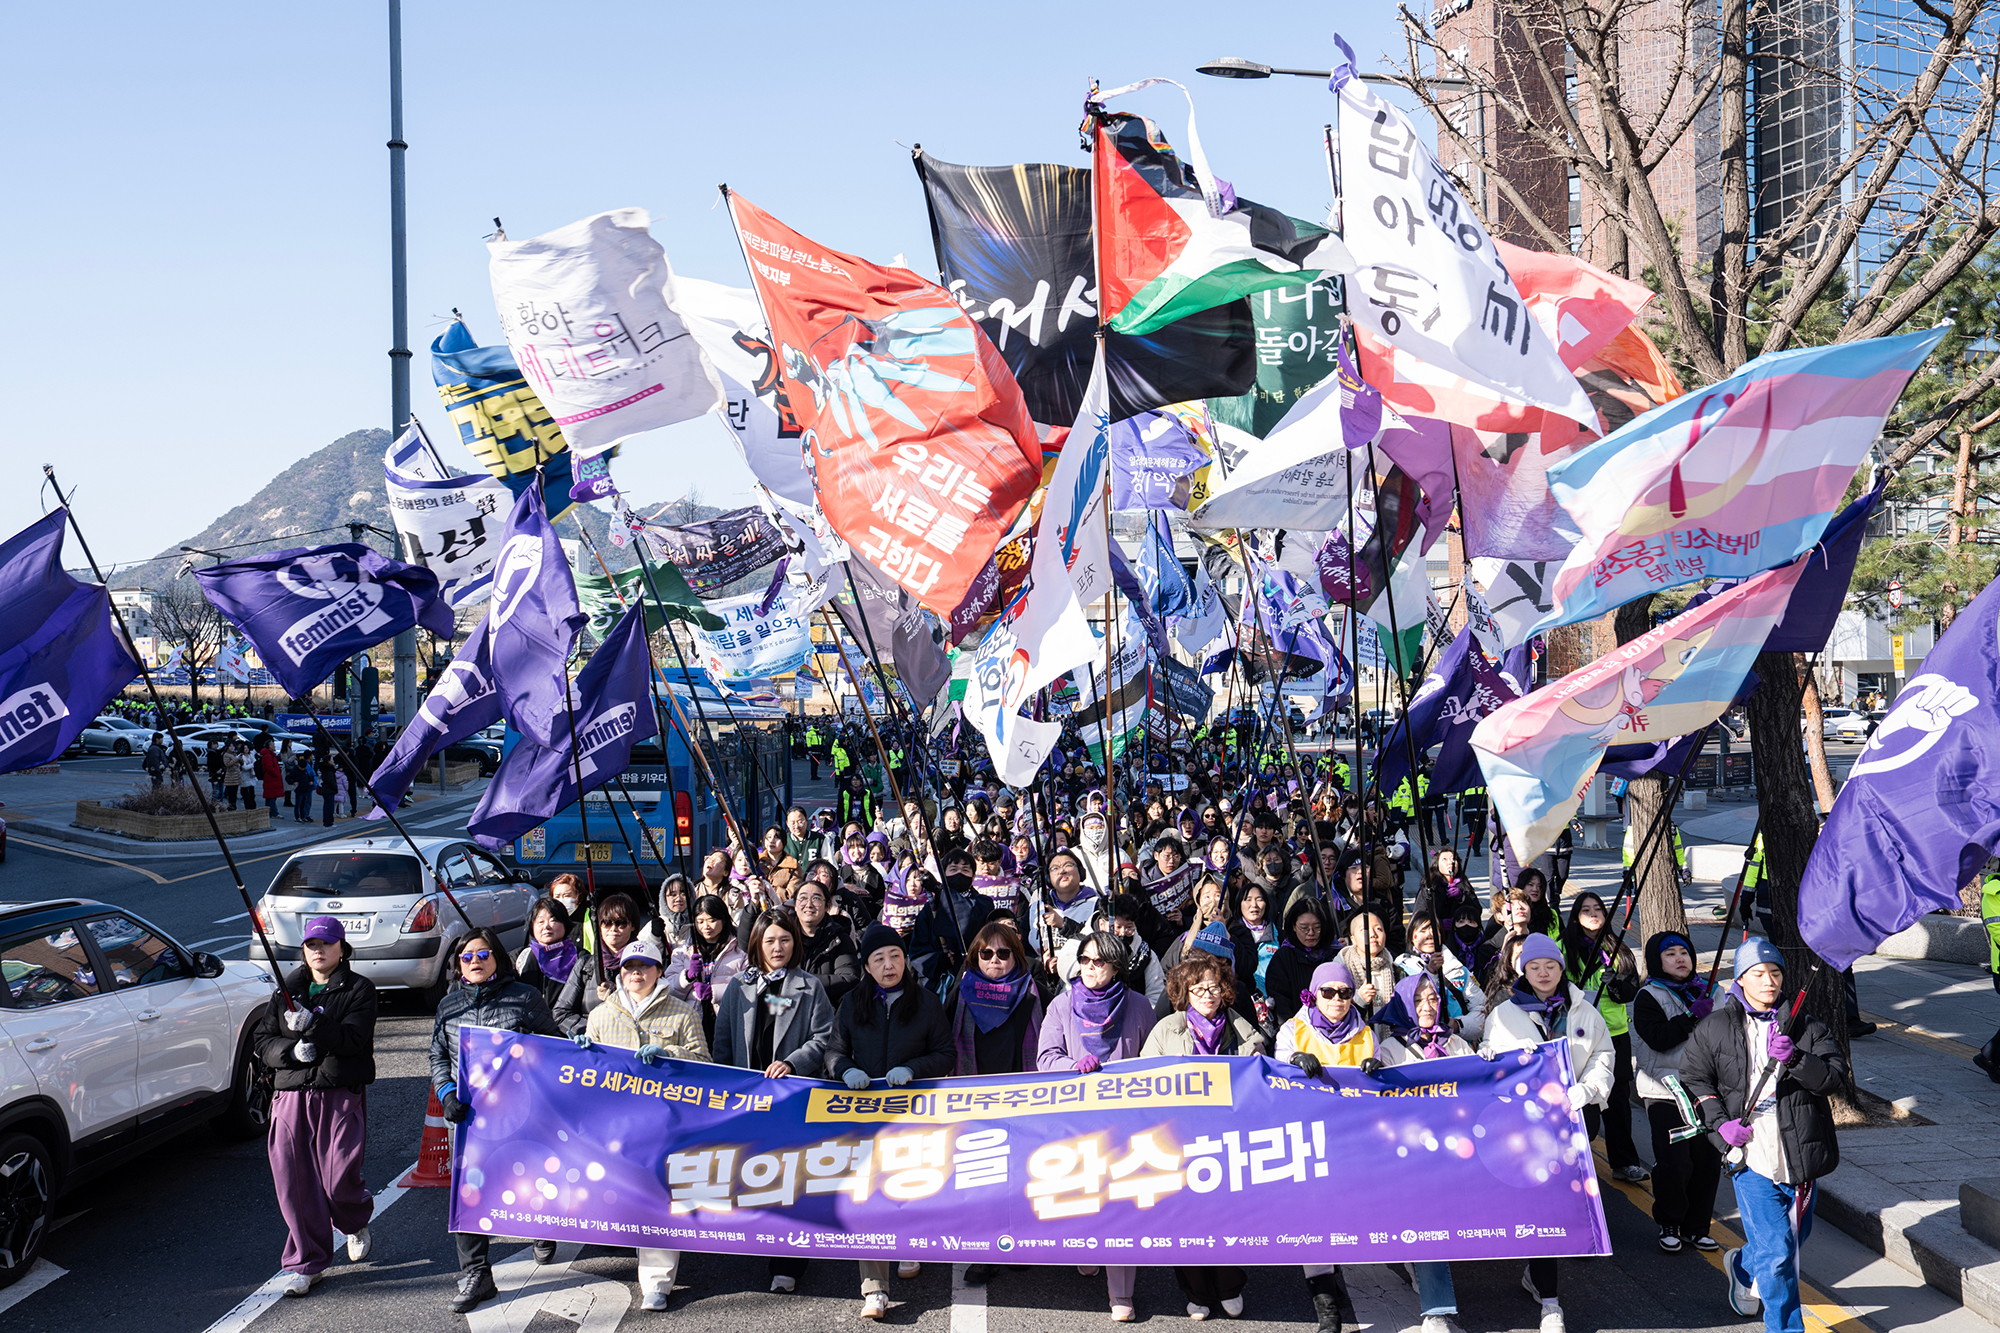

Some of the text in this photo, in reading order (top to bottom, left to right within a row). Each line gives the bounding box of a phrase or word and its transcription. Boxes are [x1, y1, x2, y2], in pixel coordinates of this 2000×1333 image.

[892, 443, 993, 514] 우리는
[870, 483, 970, 556] 서로를
[860, 525, 943, 596] 구한다
[286, 589, 377, 656] feminist
[621, 773, 668, 783] 판을 키우다
[579, 802, 609, 810] 아운수
[808, 849, 817, 861] E
[600, 1069, 705, 1105] 세계여성의
[708, 1088, 729, 1110] 날
[731, 1093, 773, 1112] 기념
[826, 1071, 1212, 1117] 성평등이 민주주의의 완성이다
[666, 1120, 1330, 1220] 빛의혁명을 완수하라!
[490, 1209, 508, 1221] 주최
[533, 1214, 577, 1229] 세계여성의
[579, 1218, 588, 1230] 날
[590, 1220, 608, 1231] 기념
[610, 1223, 640, 1235] 제41회
[641, 1225, 697, 1239] 한국여성대회
[699, 1230, 746, 1242] 조직위원회
[756, 1234, 775, 1244] 주관
[814, 1232, 897, 1246] 한국여성단체연합
[909, 1237, 928, 1248] 후원
[1063, 1238, 1085, 1248] KBS
[1152, 1237, 1172, 1247] SBS
[1239, 1236, 1269, 1246] 여성신문
[1276, 1233, 1323, 1246] OhmyNews
[1369, 1232, 1388, 1244] 협찬
[1418, 1230, 1450, 1241] 유한킴벌리
[1457, 1228, 1507, 1239] 아모레퍼시픽
